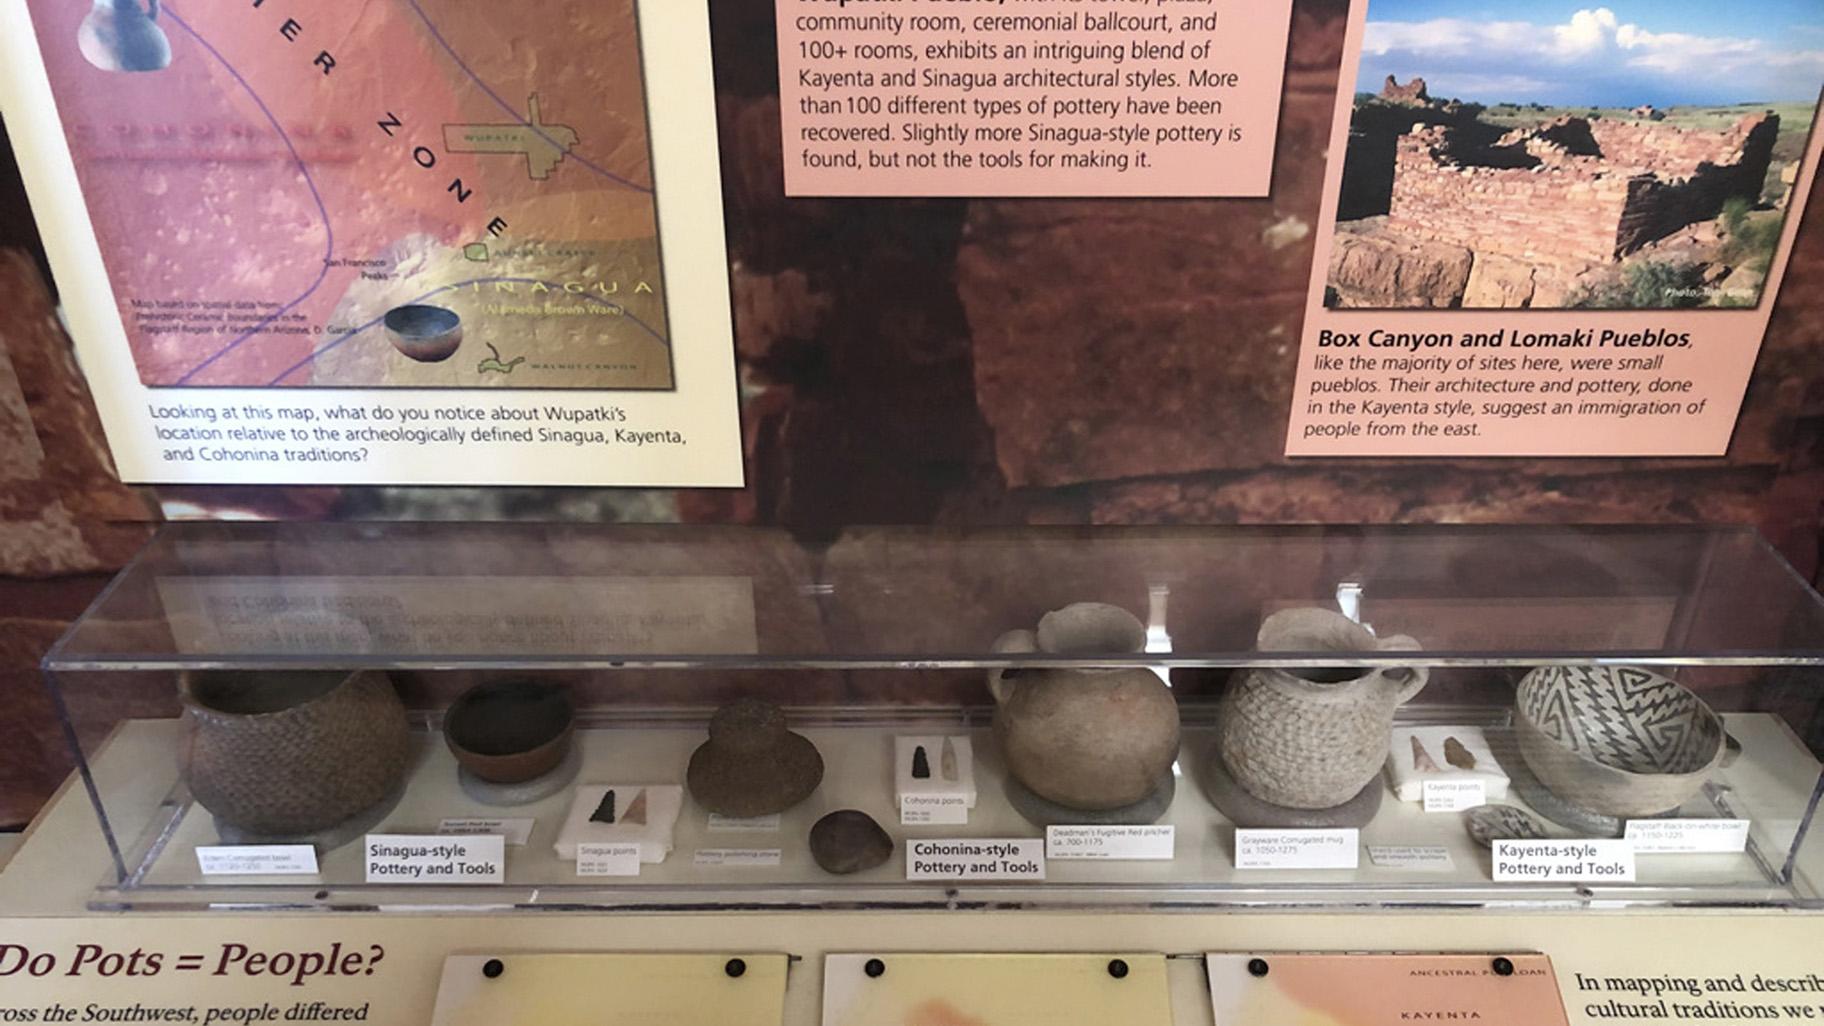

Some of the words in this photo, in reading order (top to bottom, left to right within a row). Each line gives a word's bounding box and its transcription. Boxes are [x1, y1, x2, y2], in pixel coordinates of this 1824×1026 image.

[796, 12, 904, 35] community
[910, 16, 966, 33] room,
[973, 12, 1077, 31] ceremonial
[1084, 12, 1173, 33] ballcourt,
[1180, 12, 1217, 31] and
[799, 40, 847, 59] 100+
[854, 44, 919, 62] rooms,
[925, 40, 997, 60] exhibits
[1003, 45, 1027, 60] an
[1033, 40, 1125, 64] intriguing
[1131, 40, 1184, 60] blend
[1191, 40, 1212, 60] of
[799, 69, 874, 91] Kayenta
[881, 68, 916, 87] and
[922, 68, 997, 92] Sinagua
[1003, 68, 1120, 87] architectural
[1125, 68, 1180, 92] styles.
[1189, 69, 1239, 87] More
[801, 96, 842, 114] than
[847, 97, 881, 114] 100
[887, 95, 966, 114] different
[974, 98, 1022, 119] types
[1027, 95, 1047, 114] of
[1053, 98, 1120, 119] pottery
[1126, 96, 1170, 114] have
[1176, 96, 1222, 114] been
[801, 123, 895, 142] recovered.
[902, 123, 969, 146] Slightly
[975, 126, 1023, 142] more
[1029, 123, 1150, 146] Sinagua-style
[1155, 125, 1223, 146] pottery
[1228, 123, 1242, 142] is
[802, 149, 862, 170] found,
[869, 149, 899, 168] but
[906, 151, 937, 168] not
[943, 149, 972, 168] the
[979, 149, 1023, 168] tools
[1029, 149, 1054, 168] for
[1061, 149, 1129, 172] making
[1135, 149, 1152, 168] it.
[377, 112, 507, 236] ZONE
[361, 271, 389, 281] Peaks
[588, 302, 624, 316] Ware)
[1318, 329, 1361, 348] Box
[1368, 329, 1453, 352] Canyon
[1460, 328, 1505, 348] and
[1510, 328, 1594, 348] Lomaki
[1599, 328, 1693, 349] Pueblos,
[1314, 354, 1343, 371] like
[1349, 354, 1376, 371] the
[1382, 354, 1451, 374] majority
[1456, 354, 1477, 371] of
[1479, 354, 1517, 371] sites
[1521, 354, 1563, 373] here,
[1570, 358, 1613, 371] were
[1617, 354, 1664, 371] small
[1310, 376, 1381, 396] pueblos.
[1389, 377, 1431, 393] Their
[1435, 377, 1535, 393] architecture
[1540, 377, 1573, 393] and
[1576, 378, 1641, 396] pottery,
[1647, 377, 1693, 393] done
[149, 404, 218, 422] Looking
[222, 406, 239, 419] at
[243, 404, 273, 420] this
[278, 408, 320, 423] map,
[324, 404, 369, 420] what
[371, 404, 394, 420] do
[399, 409, 430, 424] you
[434, 405, 486, 421] notice
[490, 405, 539, 421] about
[543, 405, 627, 425] Wupatki's
[1307, 399, 1323, 415] in
[1329, 399, 1356, 415] the
[1361, 400, 1429, 418] Kayenta
[1433, 399, 1475, 418] style,
[1481, 401, 1547, 418] suggest
[1551, 402, 1573, 415] an
[1578, 399, 1681, 418] immigration
[1686, 398, 1708, 415] of
[156, 425, 223, 441] location
[227, 425, 286, 441] relative
[291, 428, 309, 441] to
[313, 425, 340, 441] the
[345, 426, 466, 445] archeologically
[471, 426, 533, 442] defined
[538, 426, 609, 446] Sinagua,
[615, 428, 687, 446] Kayenta,
[1303, 421, 1361, 439] people
[1366, 420, 1405, 436] from
[1412, 420, 1439, 436] the
[1443, 422, 1481, 436] east.
[163, 446, 195, 462] and
[200, 446, 280, 462] Cohonina
[284, 447, 369, 462] traditions?
[1427, 783, 1457, 792] Kayenta
[904, 796, 940, 805] Cohonina
[1053, 828, 1095, 837] Deadman's
[1241, 835, 1279, 845] Grayware
[370, 842, 466, 859] Sinagua-style
[580, 846, 612, 857] Sinagua
[612, 846, 637, 856] points
[914, 843, 1020, 859] Cohonina-style
[1499, 844, 1597, 860] Kayenta-style
[370, 862, 423, 877] Pottery
[427, 862, 454, 875] and
[458, 862, 496, 875] Tools
[914, 860, 966, 876] Pottery
[970, 860, 997, 874] and
[1001, 860, 1039, 874] Tools
[1499, 863, 1551, 878] Pottery
[1555, 863, 1583, 876] and
[1588, 863, 1625, 876] Tools
[0, 943, 56, 977] Do
[64, 944, 164, 977] Pots
[211, 942, 385, 986] People?
[1409, 969, 1477, 977] ANCESTRAL
[1574, 973, 1601, 992] In
[1605, 976, 1702, 996] mapping
[1704, 974, 1748, 993] and
[43, 1003, 77, 1022] the
[81, 1003, 199, 1025] Southwest,
[203, 1002, 279, 1026] people
[284, 1002, 370, 1022] differed
[1401, 1011, 1481, 1020] KAYENTA
[1585, 1000, 1668, 1019] cultural
[1672, 1000, 1780, 1020] traditions
[1782, 1005, 1817, 1019] we
